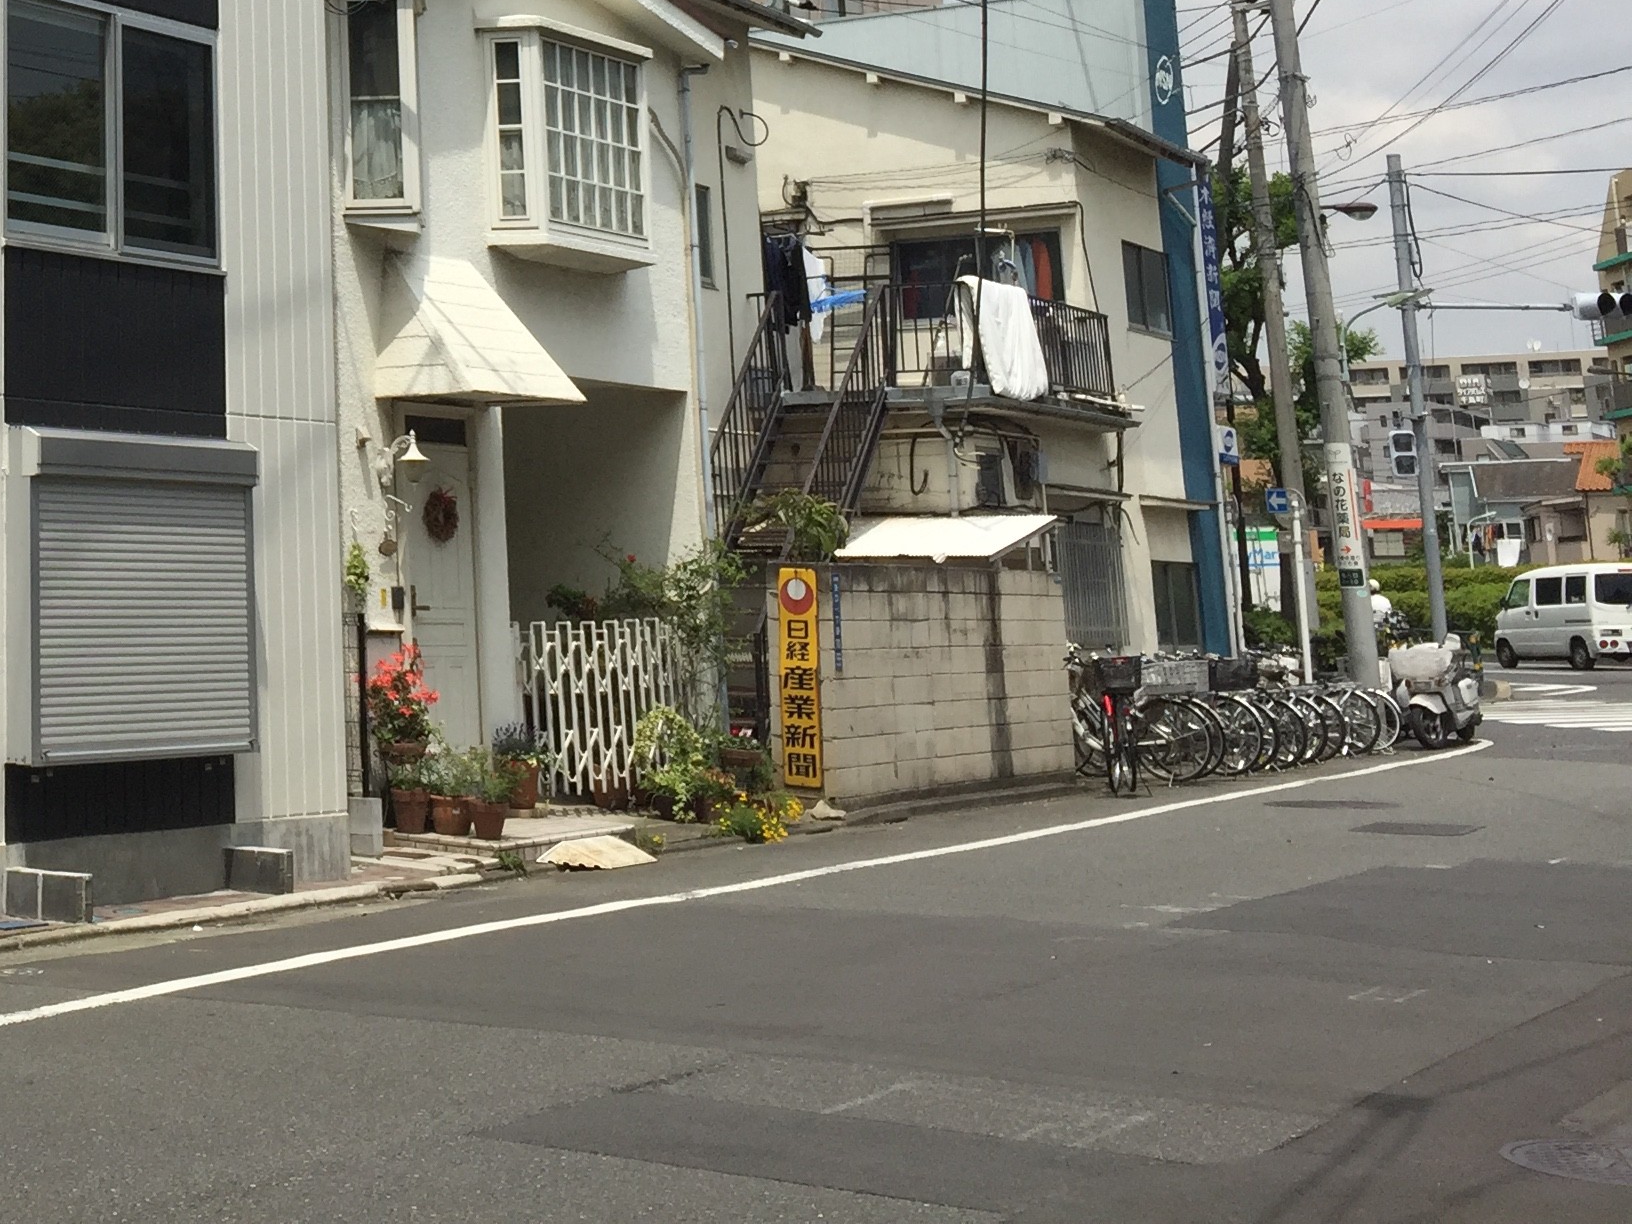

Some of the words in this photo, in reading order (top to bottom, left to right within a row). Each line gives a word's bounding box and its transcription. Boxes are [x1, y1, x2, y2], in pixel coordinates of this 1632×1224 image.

[1198, 173, 1223, 313] 本経済新聞
[1332, 471, 1351, 539] なの花薬局
[783, 618, 818, 779] 日経産業新聞
